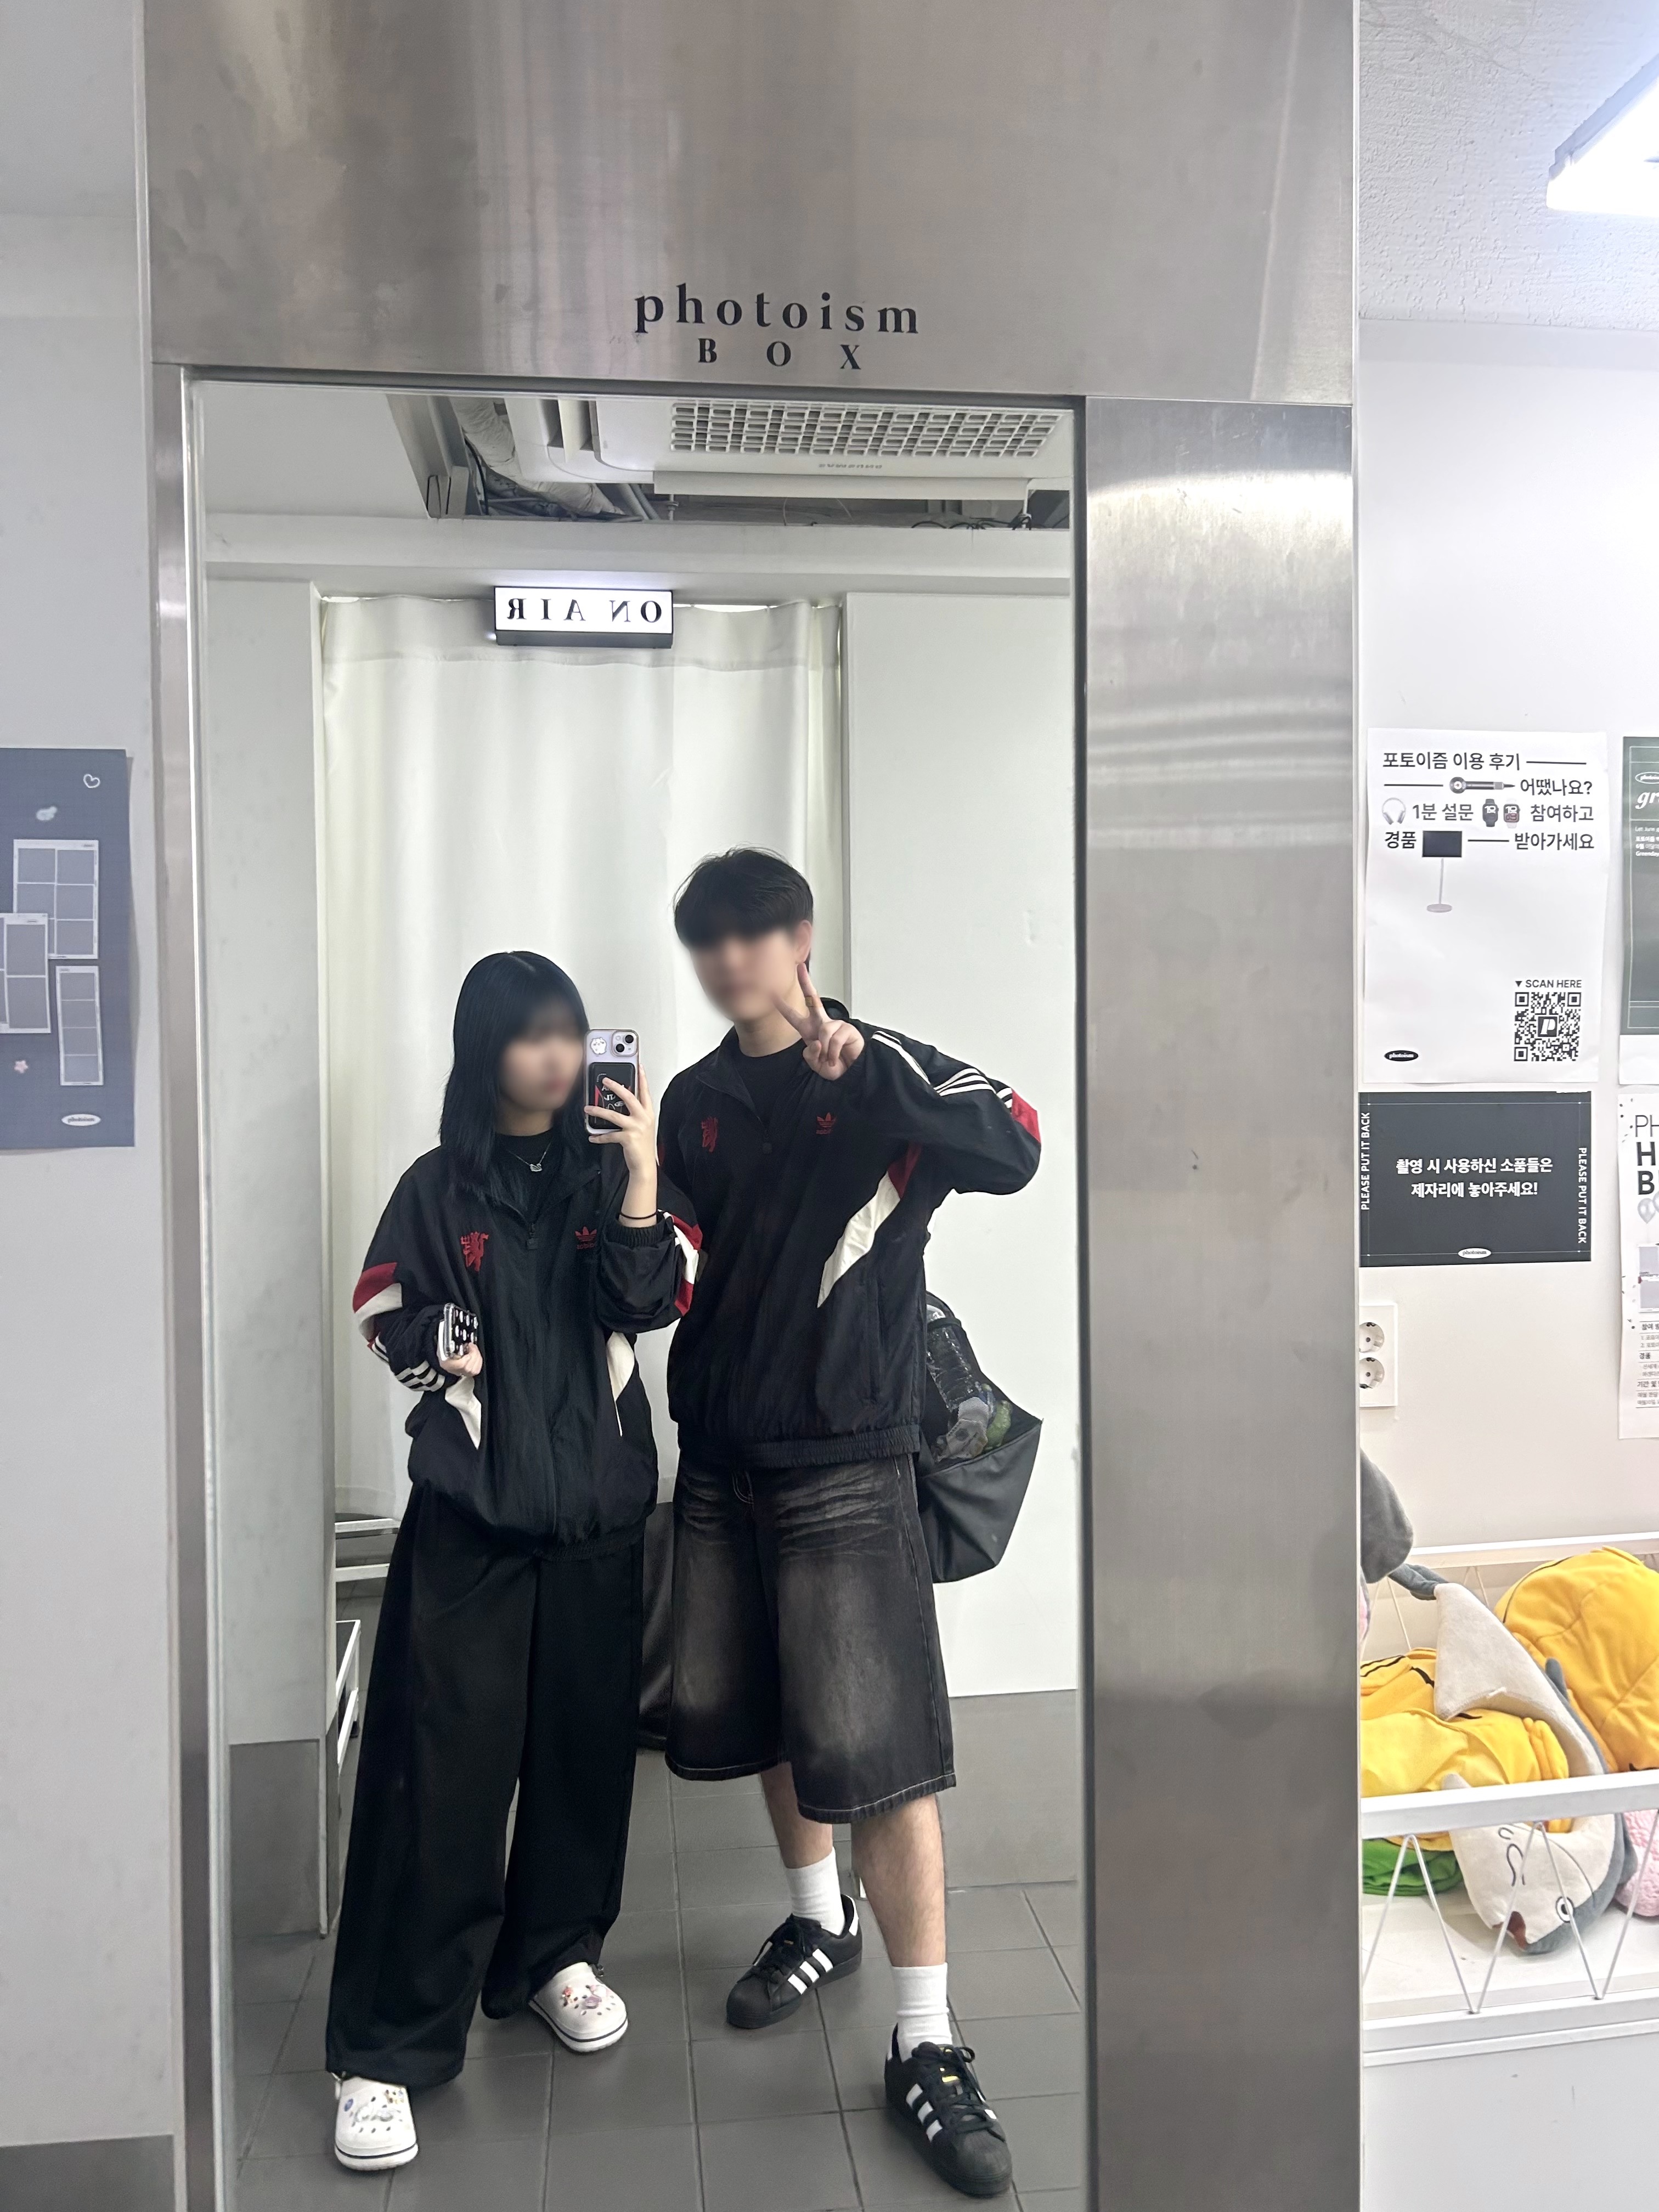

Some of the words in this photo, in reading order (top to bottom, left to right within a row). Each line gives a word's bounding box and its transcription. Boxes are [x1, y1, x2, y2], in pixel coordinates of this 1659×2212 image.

[635, 283, 919, 334] photoism
[1383, 751, 1448, 770] 포토이즘
[1453, 752, 1485, 770] 이용
[1489, 753, 1520, 771] 후기
[1520, 778, 1593, 796] 어땠나요?
[1412, 803, 1437, 821] 1분
[1442, 803, 1474, 821] 설문
[1530, 804, 1594, 822] 참여하고
[1384, 831, 1417, 849] 경품
[1514, 832, 1595, 850] 받아가세요
[1525, 979, 1554, 988] SCAN
[1556, 979, 1582, 988] HERE
[1361, 1111, 1370, 1138] BACK
[1361, 1141, 1370, 1151] IT
[1361, 1153, 1370, 1173] PUT
[1396, 1158, 1423, 1175] 촬영
[1426, 1158, 1440, 1174] 시
[1443, 1158, 1497, 1174] 사용하신
[1500, 1157, 1553, 1173] 소품들은
[1578, 1147, 1587, 1183] PLEASE
[1361, 1175, 1370, 1211] PLEASE
[1410, 1182, 1464, 1198] 제자리에
[1468, 1181, 1538, 1198] 놓아주세요!
[1578, 1185, 1587, 1204] PUT
[1578, 1206, 1587, 1216] IT
[1578, 1217, 1587, 1244] BACK
